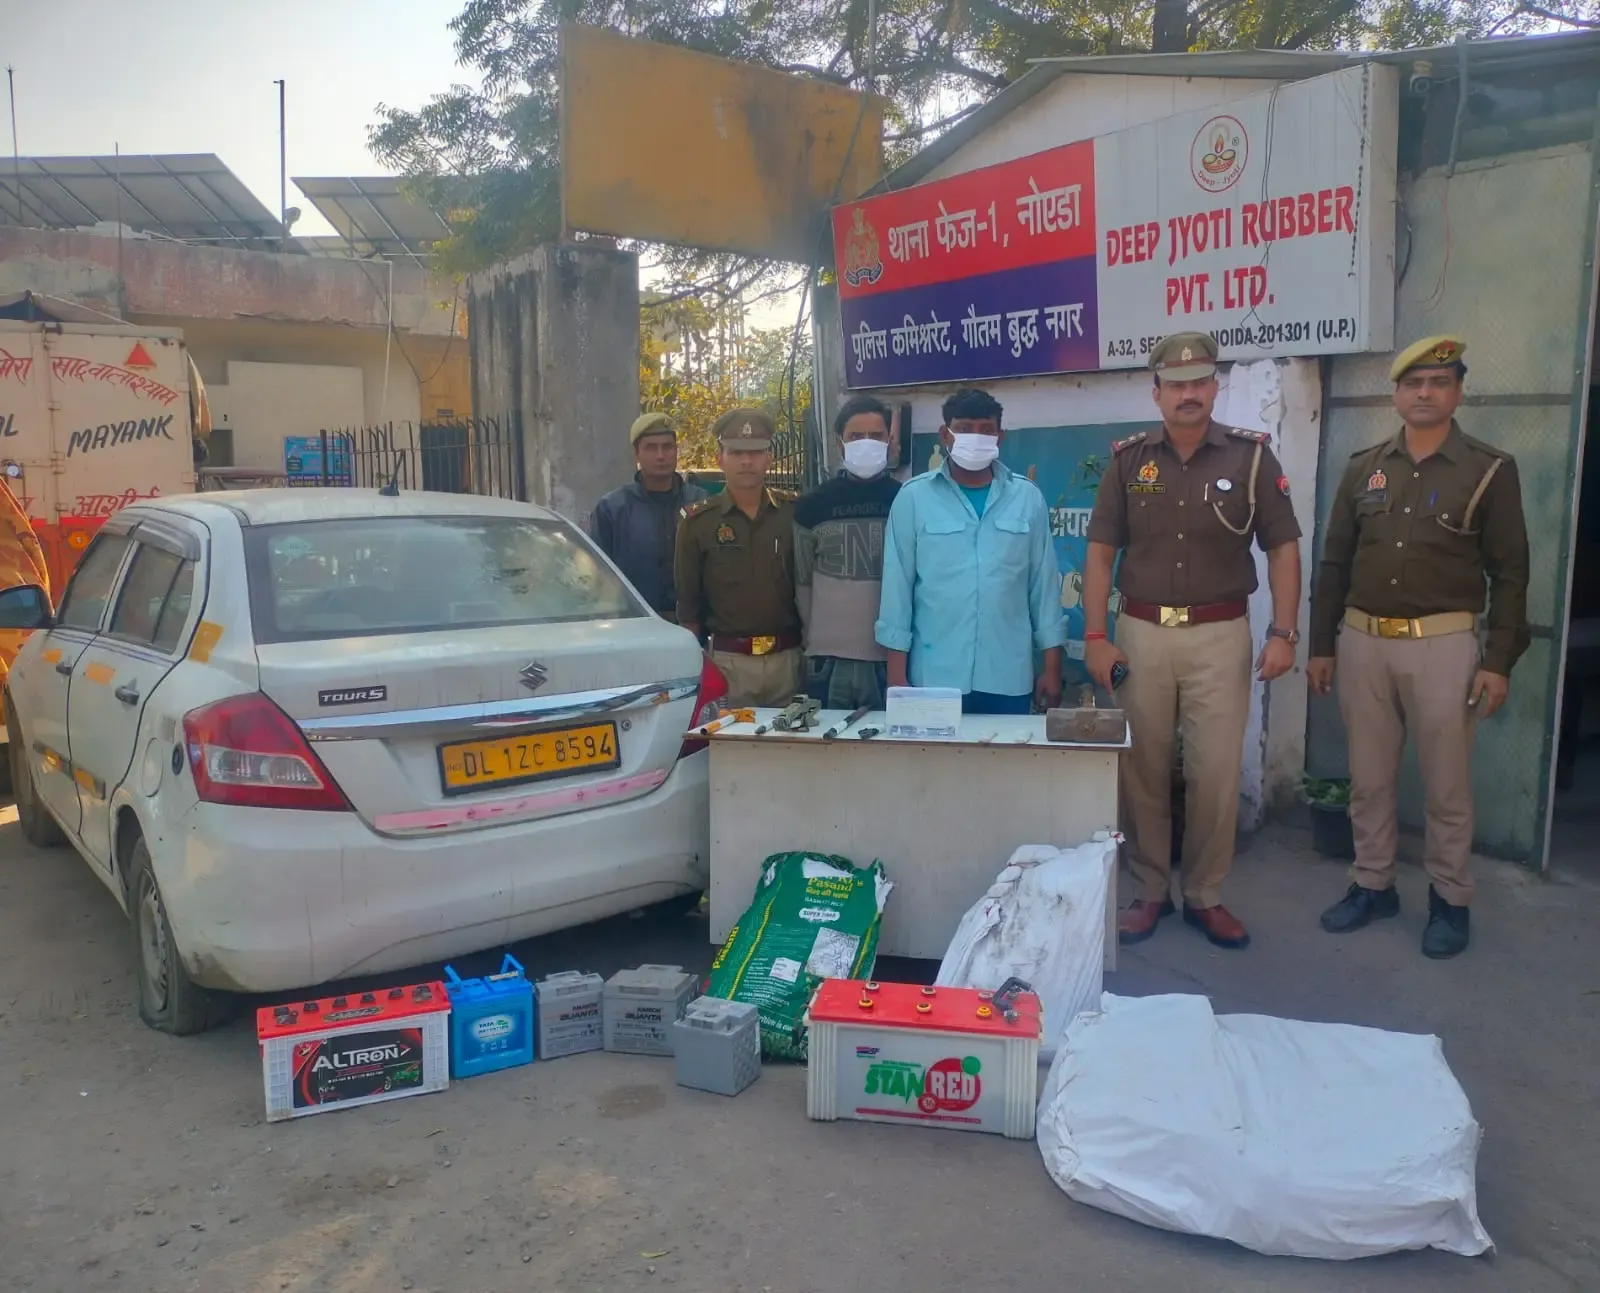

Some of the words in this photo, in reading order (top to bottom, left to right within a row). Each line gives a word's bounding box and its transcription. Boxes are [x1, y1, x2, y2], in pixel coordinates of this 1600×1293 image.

[888, 220, 929, 262] थाना
[1016, 176, 1081, 236] नोएडा
[1106, 222, 1160, 267] DEEP
[1168, 207, 1232, 267] JYOTI
[1241, 186, 1355, 249] RUBBER
[1166, 273, 1214, 317] PVT.
[1223, 266, 1275, 309] LTD.
[851, 321, 888, 373] पुलिस
[961, 304, 1002, 348] गौतम
[1006, 309, 1040, 358] बुद्ध
[1044, 303, 1085, 339] नगर
[1107, 339, 1137, 358] A-32,
[1316, 318, 1357, 345] (U.P.)
[67, 414, 175, 458] MAYANK
[463, 751, 494, 778] DL
[504, 743, 545, 772] 1ZC
[555, 732, 612, 762] 8594
[312, 1044, 400, 1073] ALTRON
[929, 1070, 976, 1102] RED
